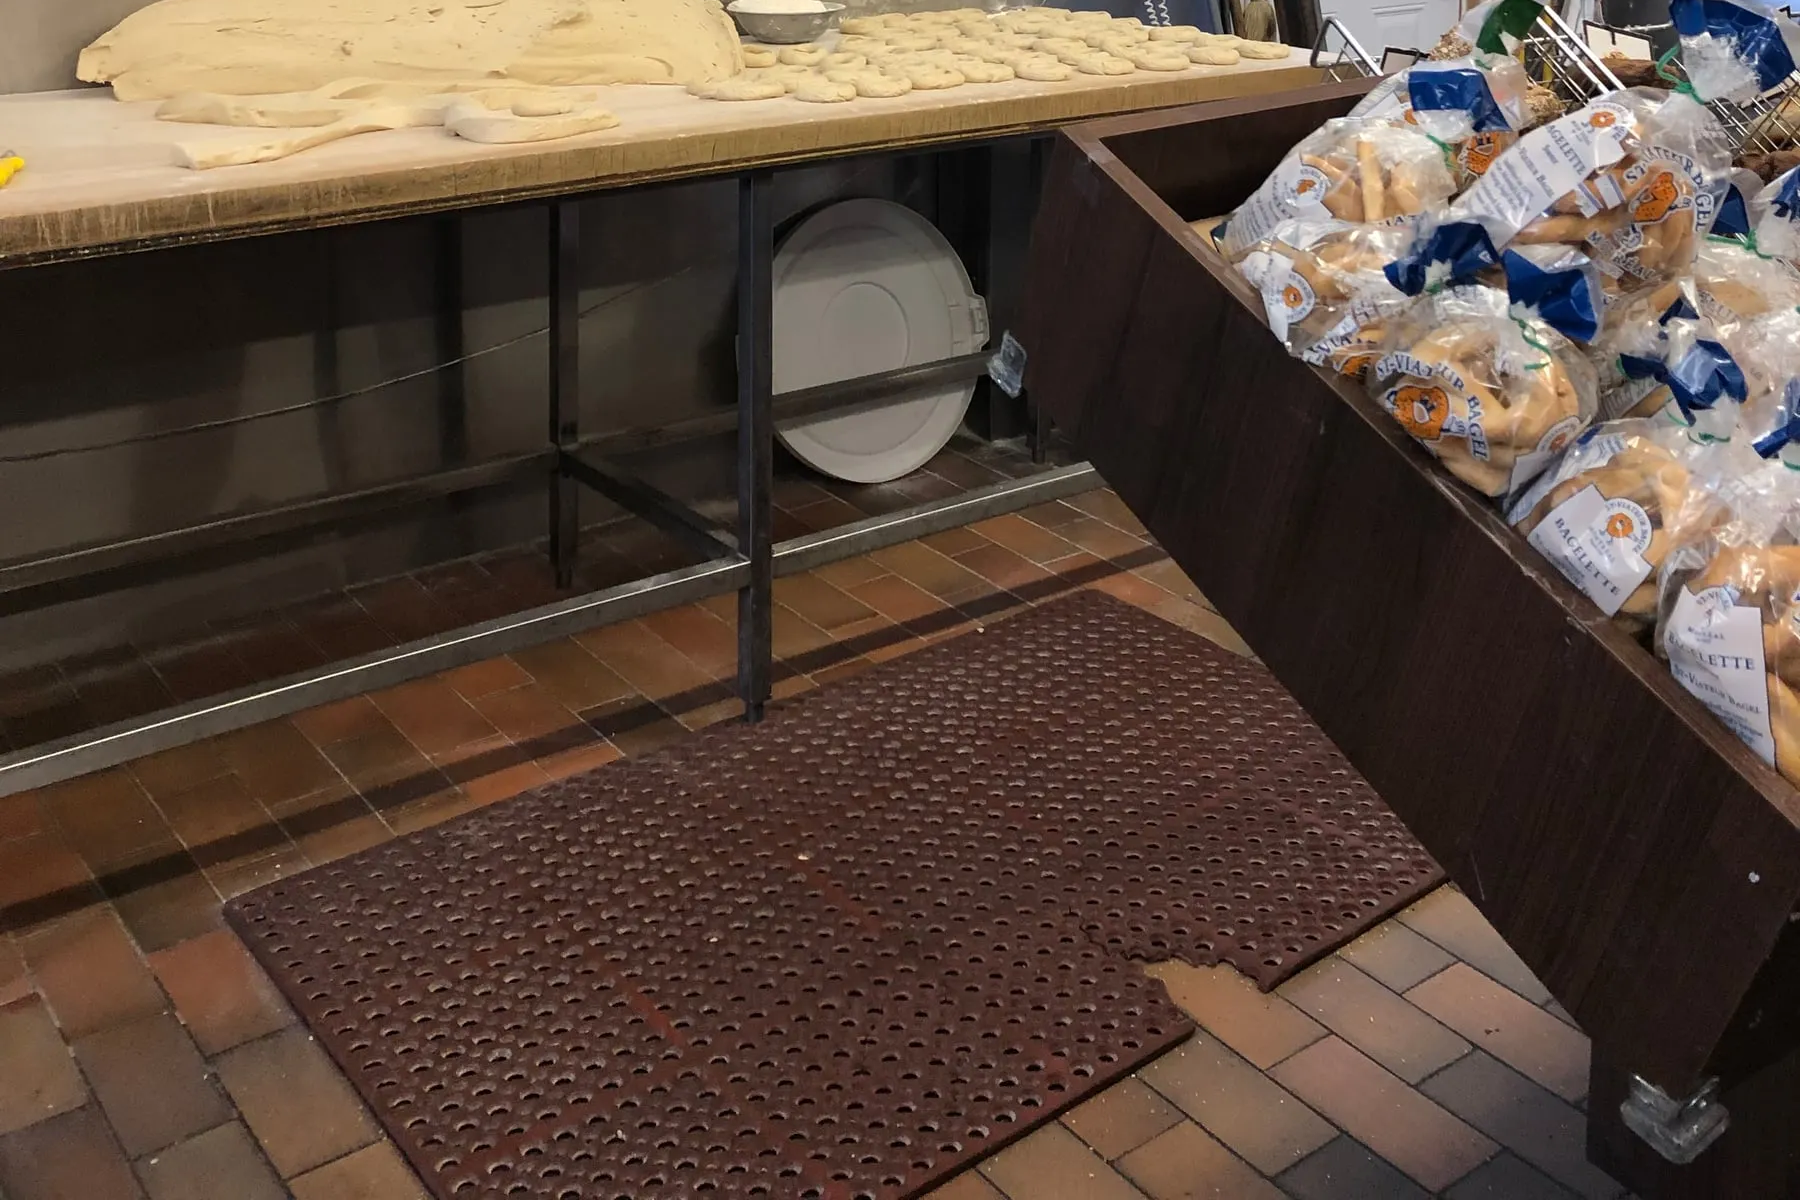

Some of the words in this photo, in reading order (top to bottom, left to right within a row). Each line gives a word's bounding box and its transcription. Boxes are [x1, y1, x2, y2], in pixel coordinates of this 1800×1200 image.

[1547, 124, 1588, 176] AGELETTE
[1467, 394, 1488, 459] BAGEL
[1555, 517, 1621, 596] BAGELETTE
[1668, 631, 1755, 671] BLETTE
